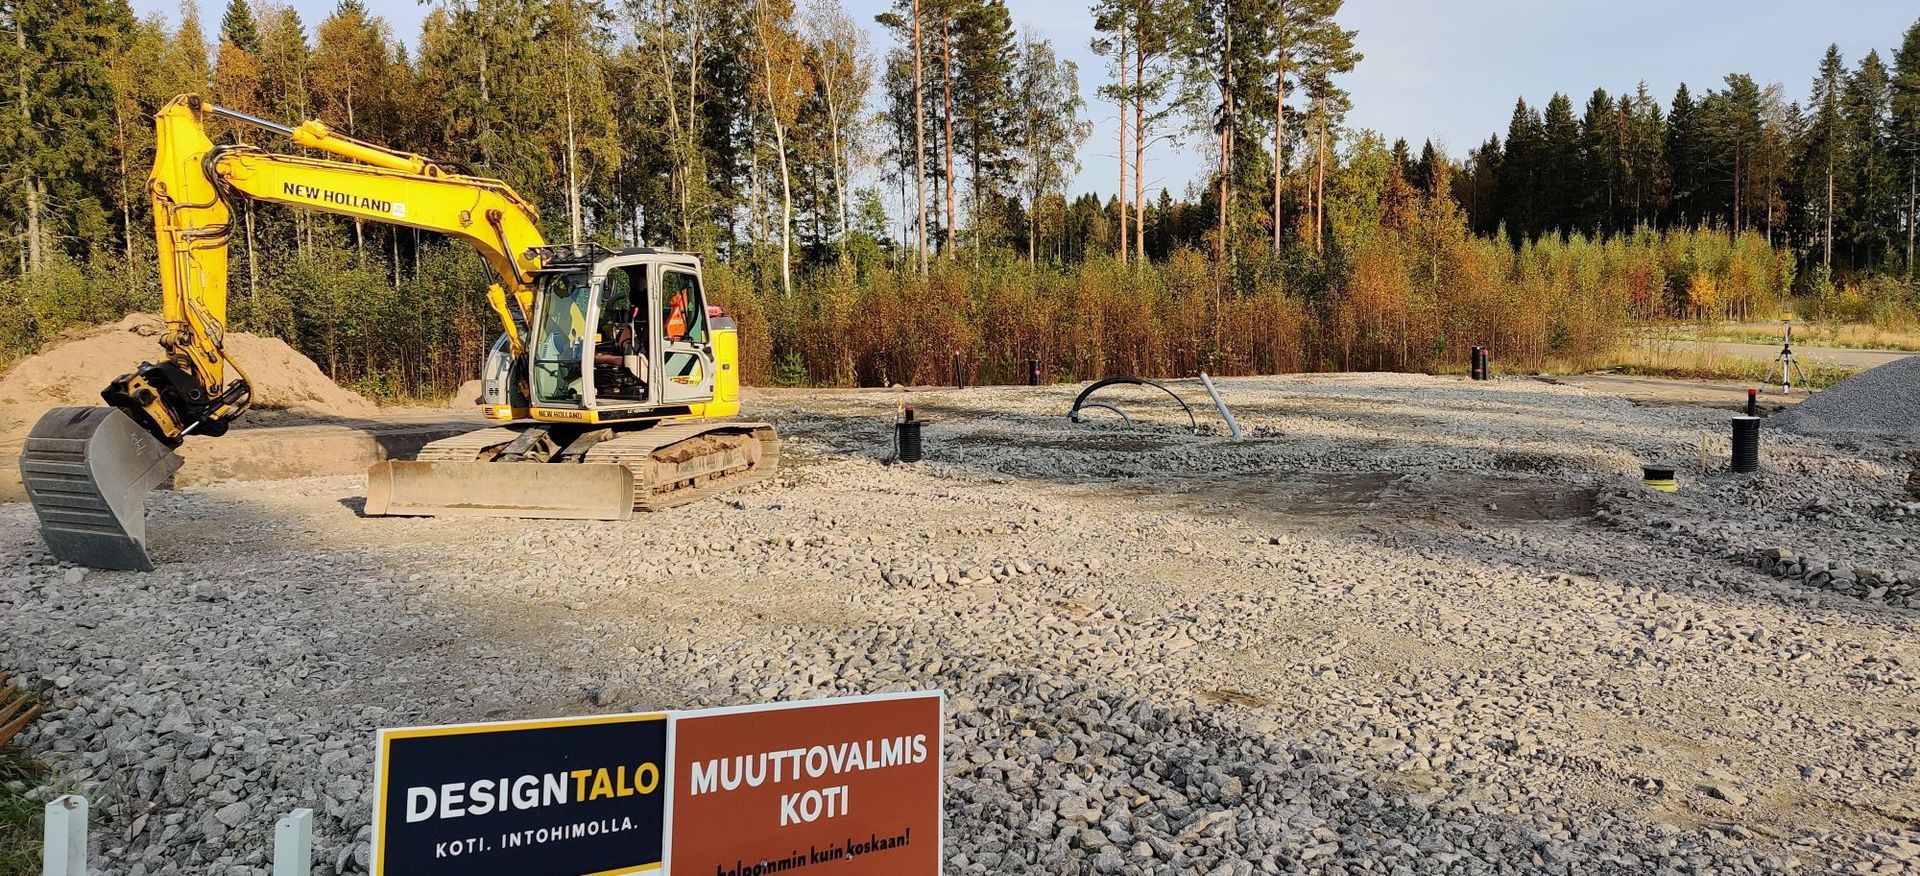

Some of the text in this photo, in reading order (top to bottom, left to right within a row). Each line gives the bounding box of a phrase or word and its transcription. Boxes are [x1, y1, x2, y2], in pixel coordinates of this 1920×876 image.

[283, 182, 320, 200] NEW
[323, 190, 391, 213] HOLLAND
[538, 410, 583, 419] NEW HOLLAND
[690, 734, 927, 796] MUUTTOVALMIS
[406, 762, 660, 823] DESIGNTALO
[780, 785, 849, 827] KOTI
[435, 816, 639, 858] KOTI. INTOHIMOLLA.
[810, 843, 843, 865] kuin
[846, 828, 910, 859] koskaan!
